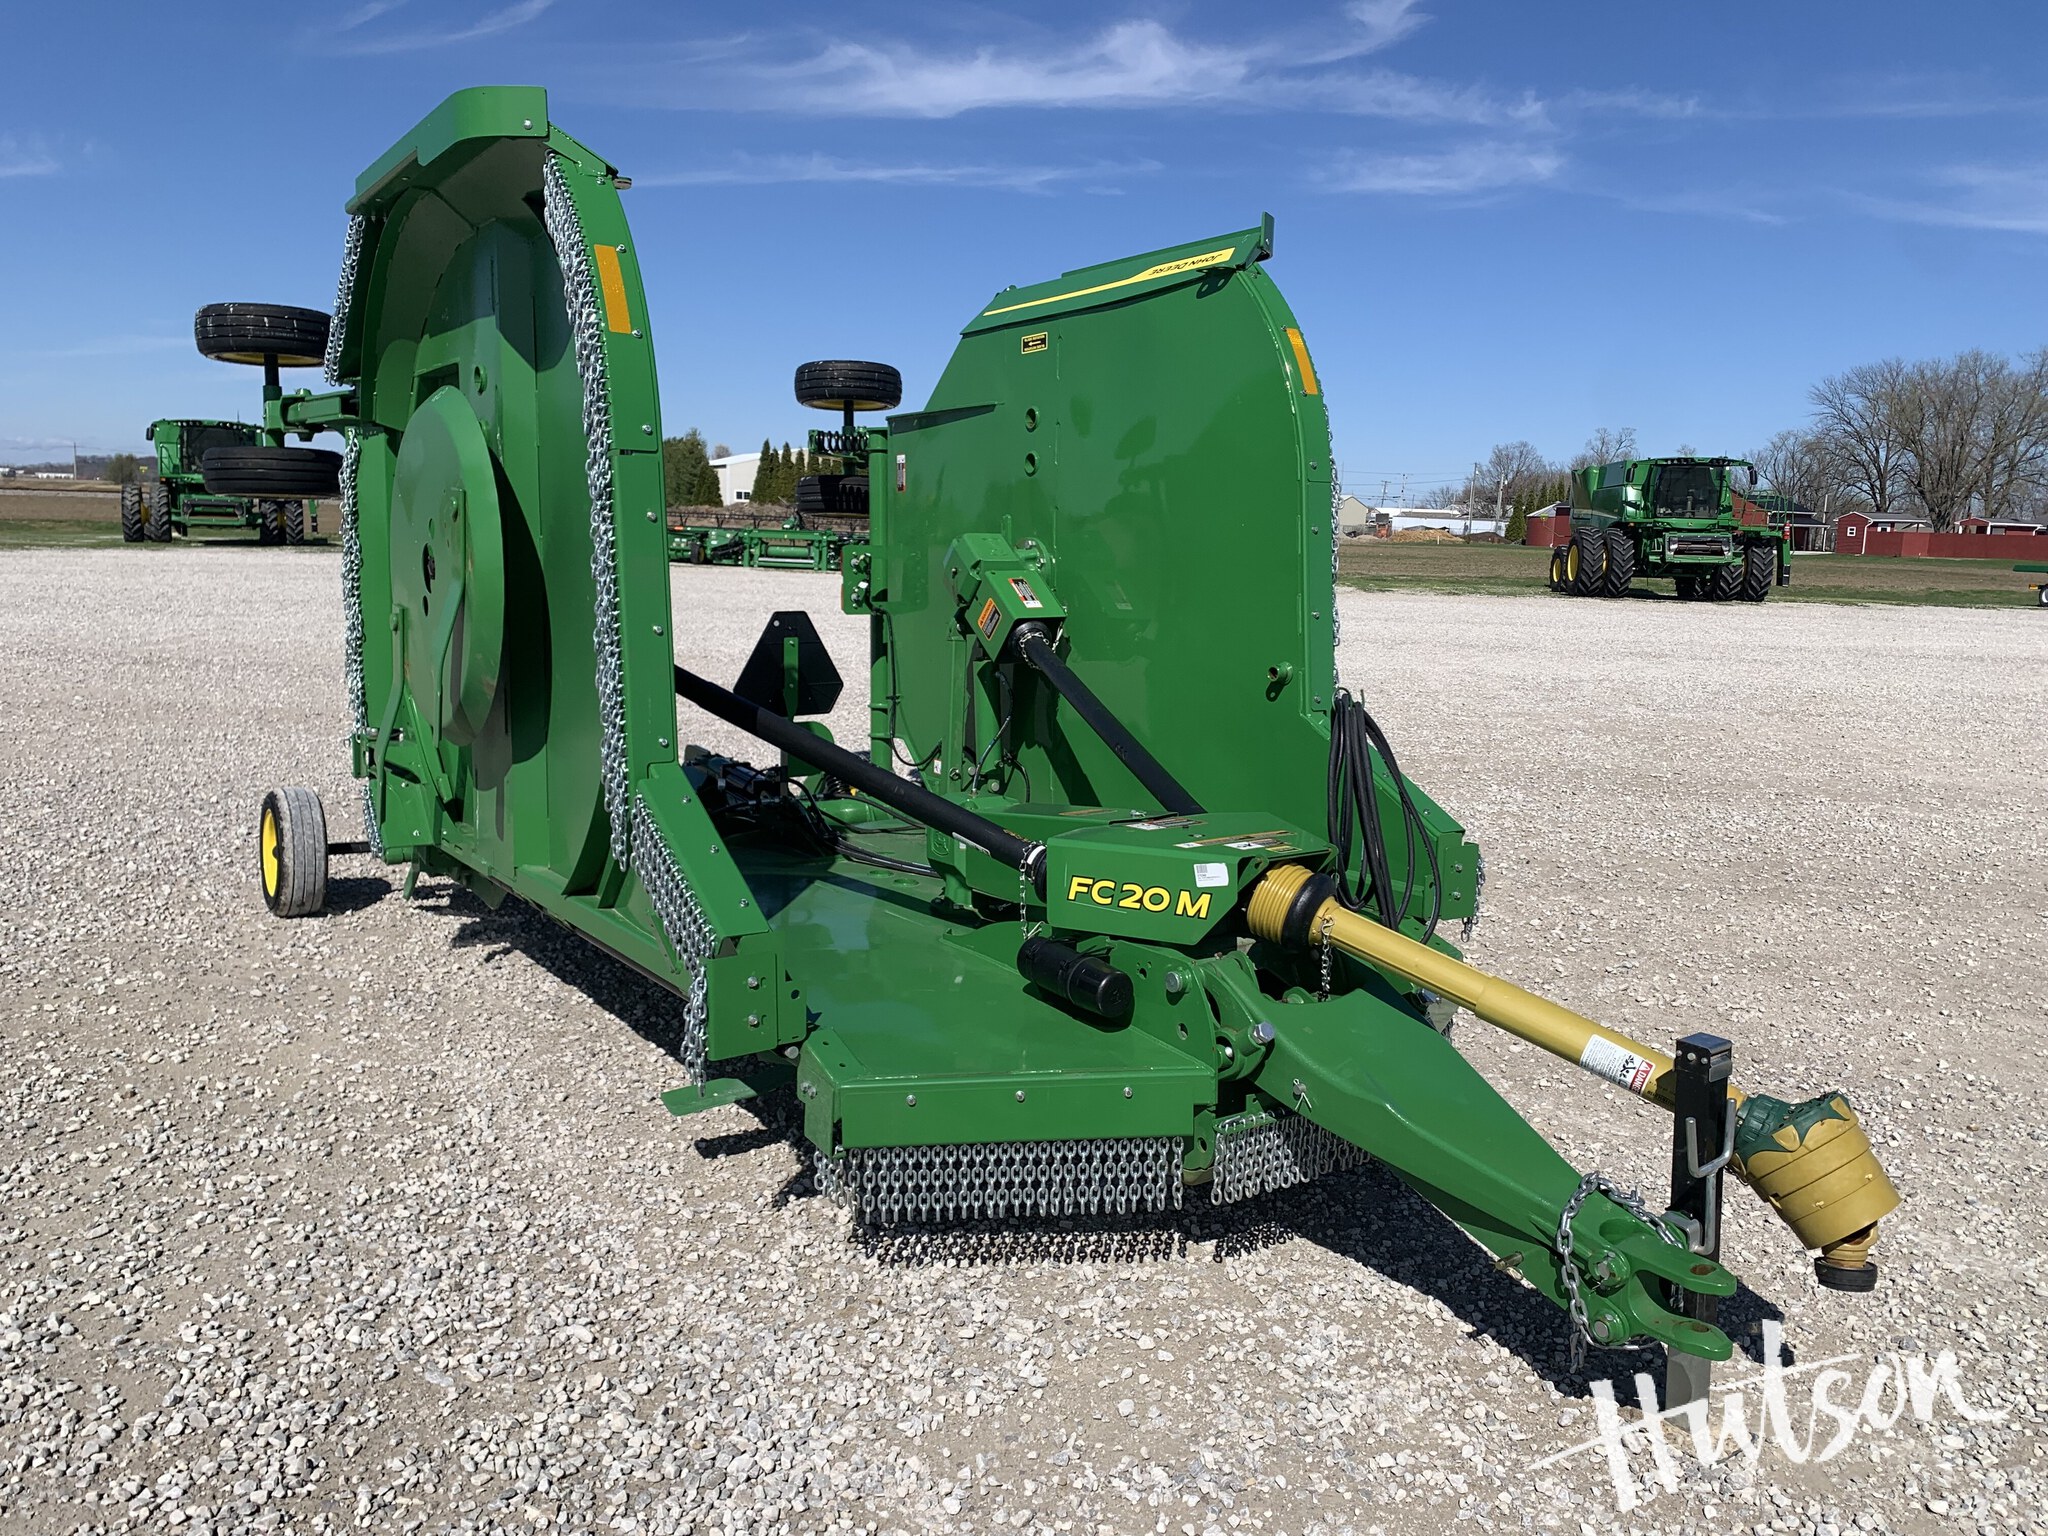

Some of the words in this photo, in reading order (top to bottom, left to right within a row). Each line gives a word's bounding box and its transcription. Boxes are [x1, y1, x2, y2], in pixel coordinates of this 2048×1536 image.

[1188, 253, 1223, 267] JOHN
[1148, 261, 1189, 276] DEERE
[1067, 875, 1117, 905] FC
[1118, 882, 1171, 912] 20
[1174, 889, 1213, 920] M
